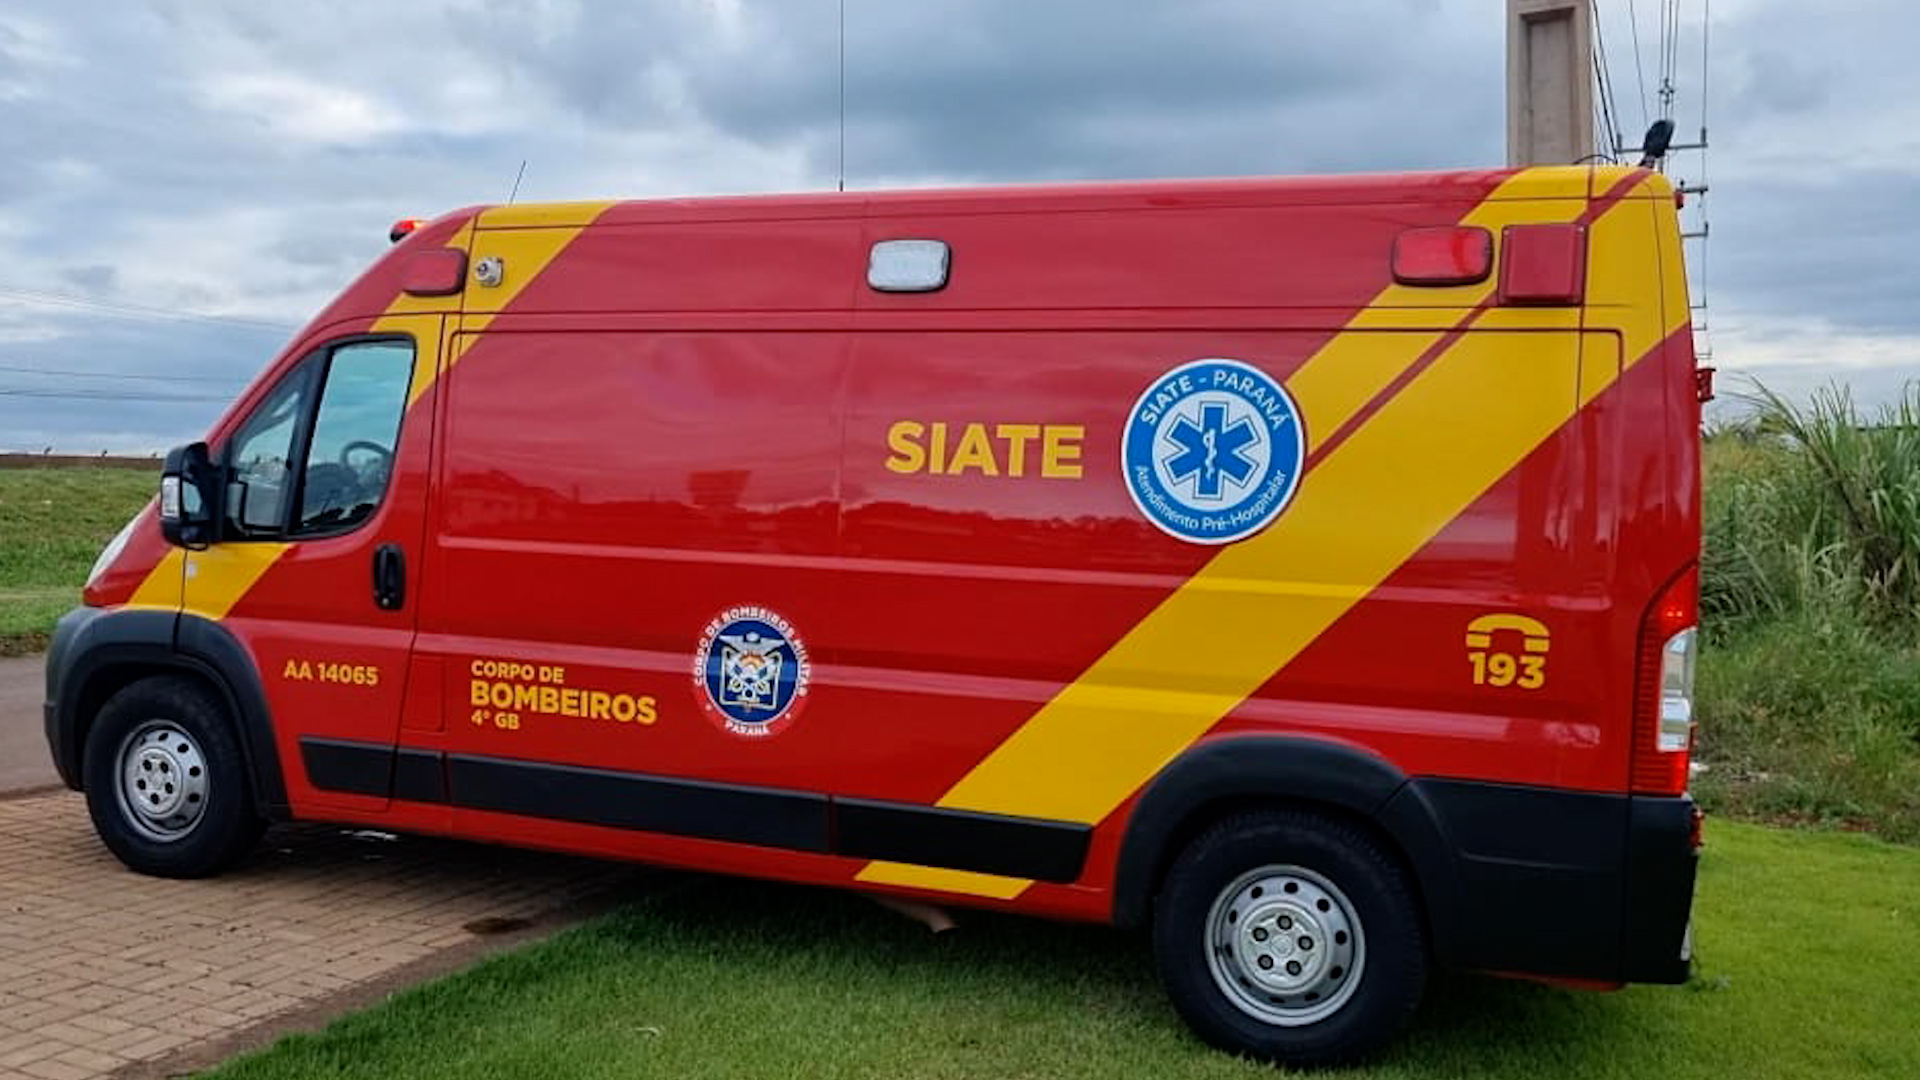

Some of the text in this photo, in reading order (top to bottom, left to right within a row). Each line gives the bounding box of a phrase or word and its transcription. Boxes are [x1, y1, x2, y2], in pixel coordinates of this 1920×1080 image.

[1141, 375, 1193, 425] SIATE
[1213, 369, 1291, 430] PARANÁ
[885, 420, 1086, 479] SIATE
[1135, 465, 1287, 531] Atendimento Pré-Hospitalar
[283, 659, 379, 686] AA 14065
[471, 660, 565, 684] CORPO DE
[1467, 651, 1546, 690] 193
[471, 679, 657, 725] BOMBEIROS
[494, 712, 520, 730] GB
